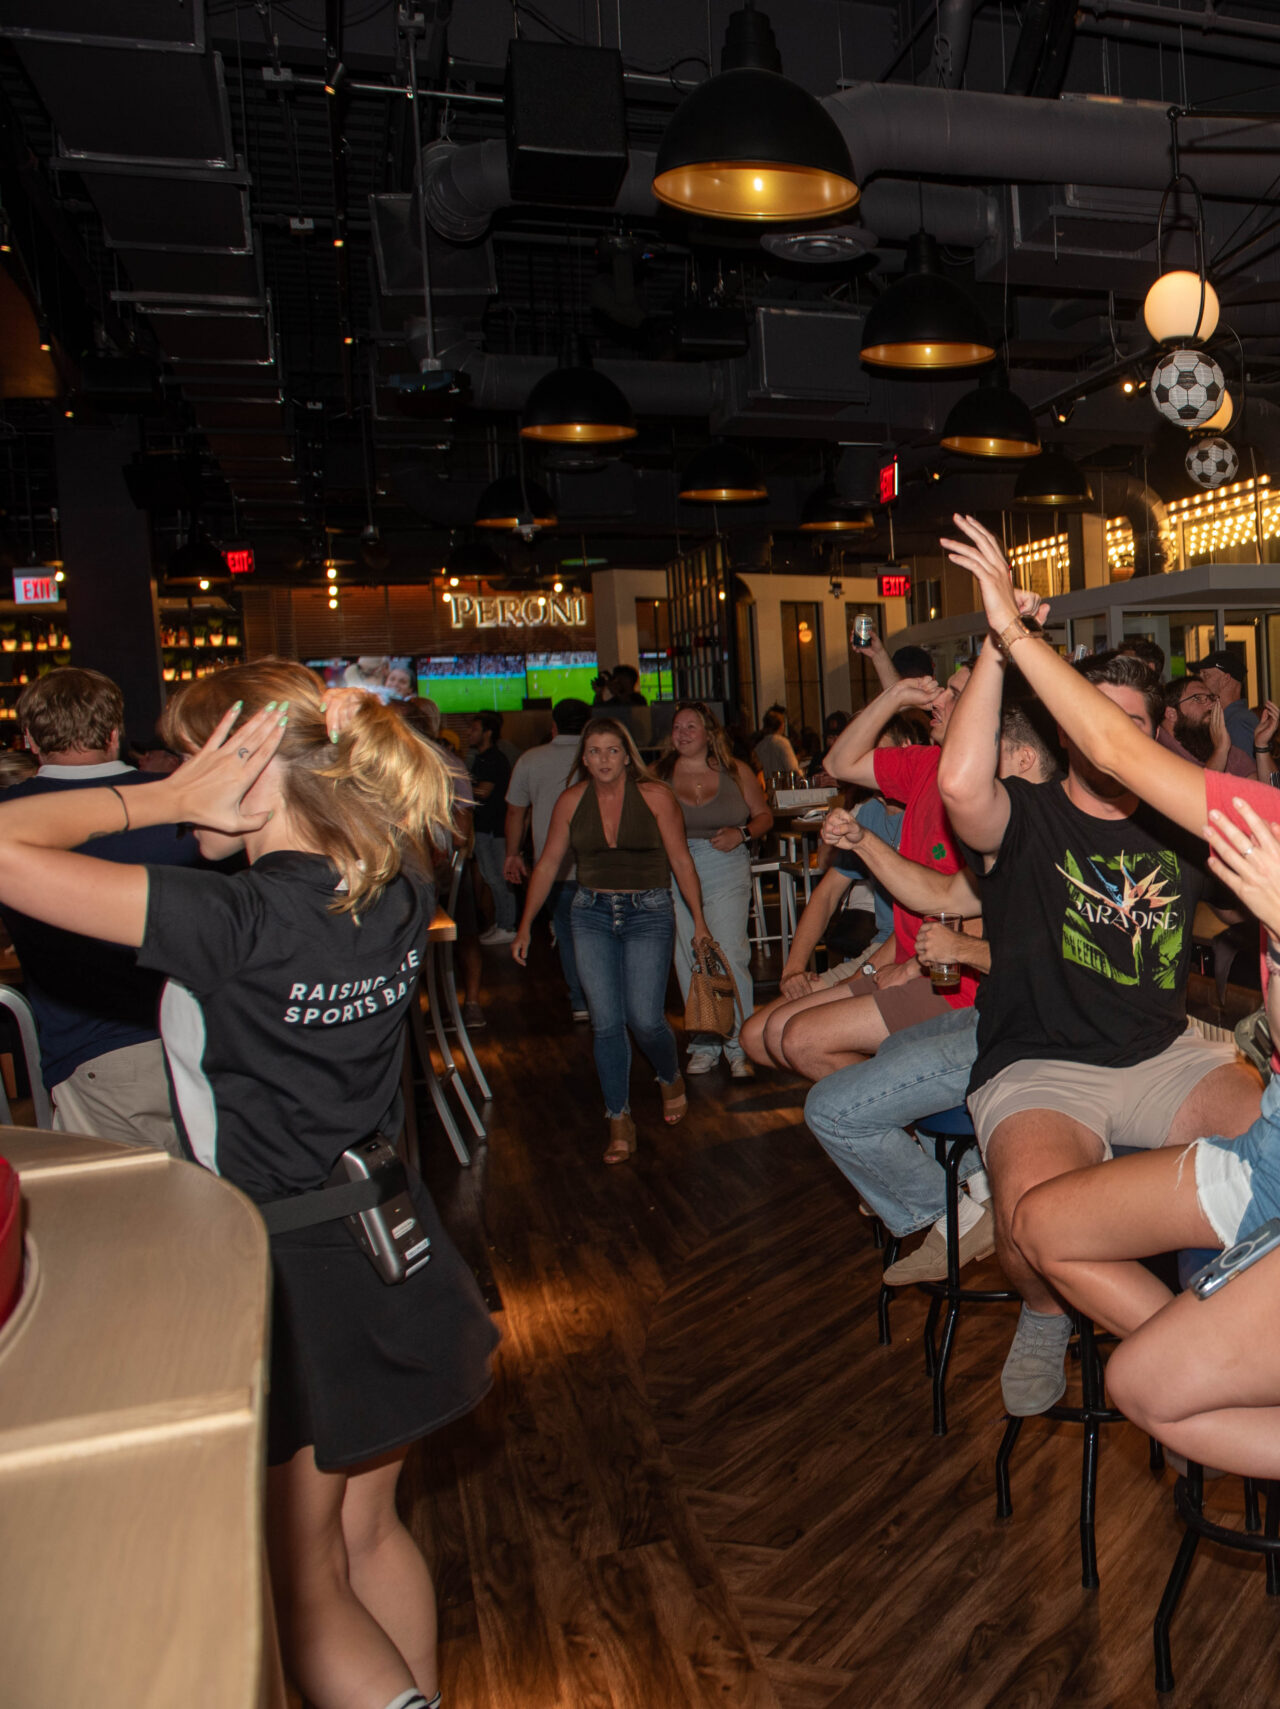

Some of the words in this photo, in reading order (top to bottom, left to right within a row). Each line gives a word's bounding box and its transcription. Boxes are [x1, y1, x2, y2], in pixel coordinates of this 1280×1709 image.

[227, 551, 249, 573] EXIT
[22, 578, 51, 601] EXIT
[882, 576, 905, 597] EXIT
[450, 593, 587, 629] PERONI
[283, 996, 378, 1024] SPORTS
[382, 975, 416, 1006] BA
